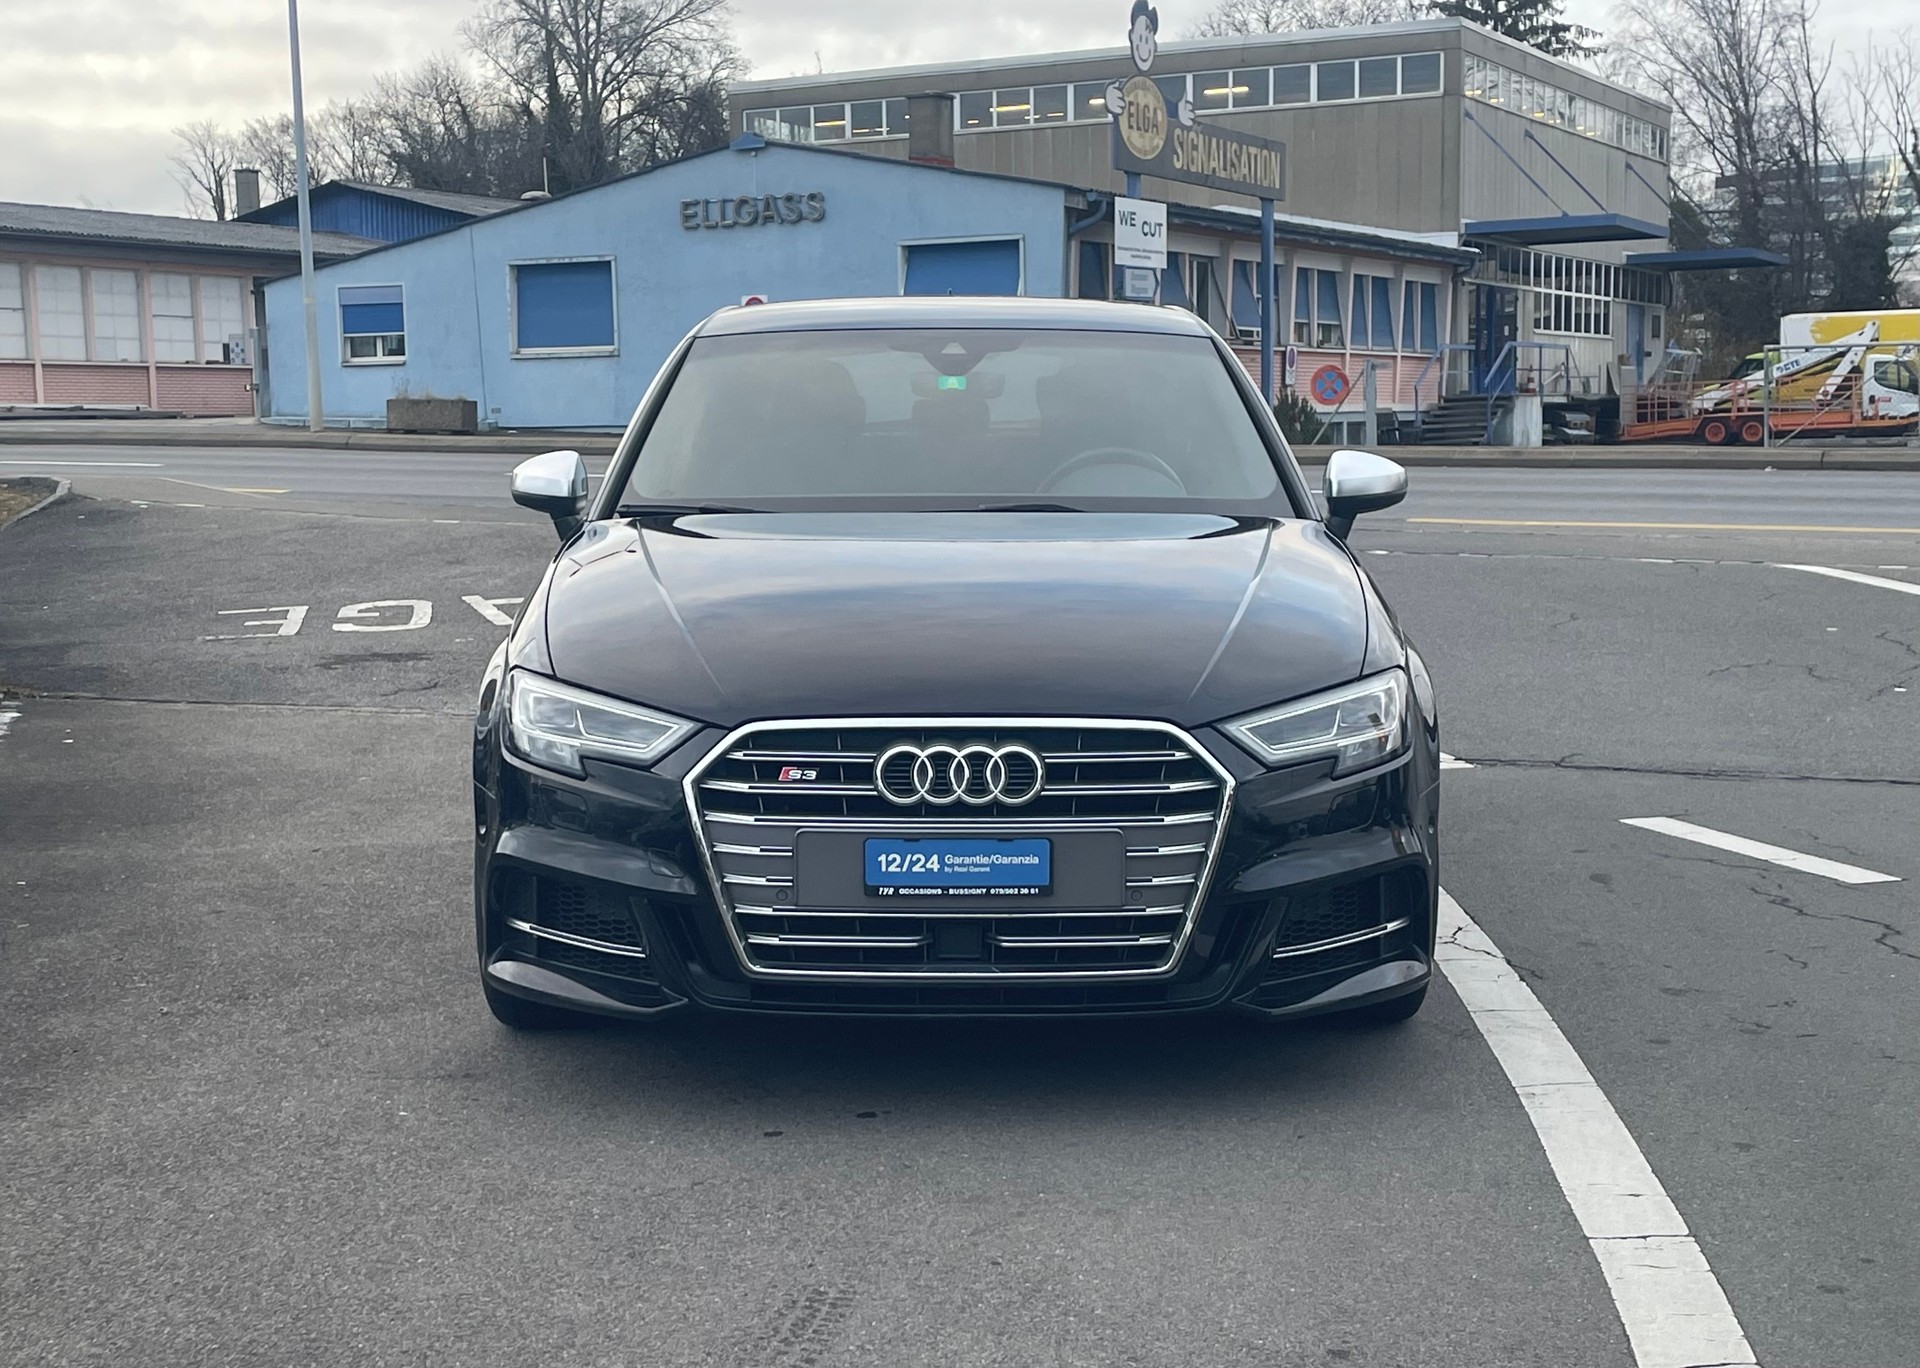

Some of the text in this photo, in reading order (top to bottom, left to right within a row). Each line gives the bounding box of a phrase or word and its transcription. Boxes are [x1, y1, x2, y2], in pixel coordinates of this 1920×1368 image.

[1128, 101, 1160, 136] ELGA
[1173, 127, 1281, 189] SIGNALISATION
[680, 191, 825, 229] ELLGASS
[1118, 209, 1163, 238] WE CUT
[788, 769, 817, 781] S3
[877, 853, 940, 873] 12/24
[944, 854, 1039, 865] Garantie/Garanzia
[944, 865, 953, 874] by
[898, 887, 943, 895] OCCASIONS
[948, 887, 987, 895] BUSSIGNY
